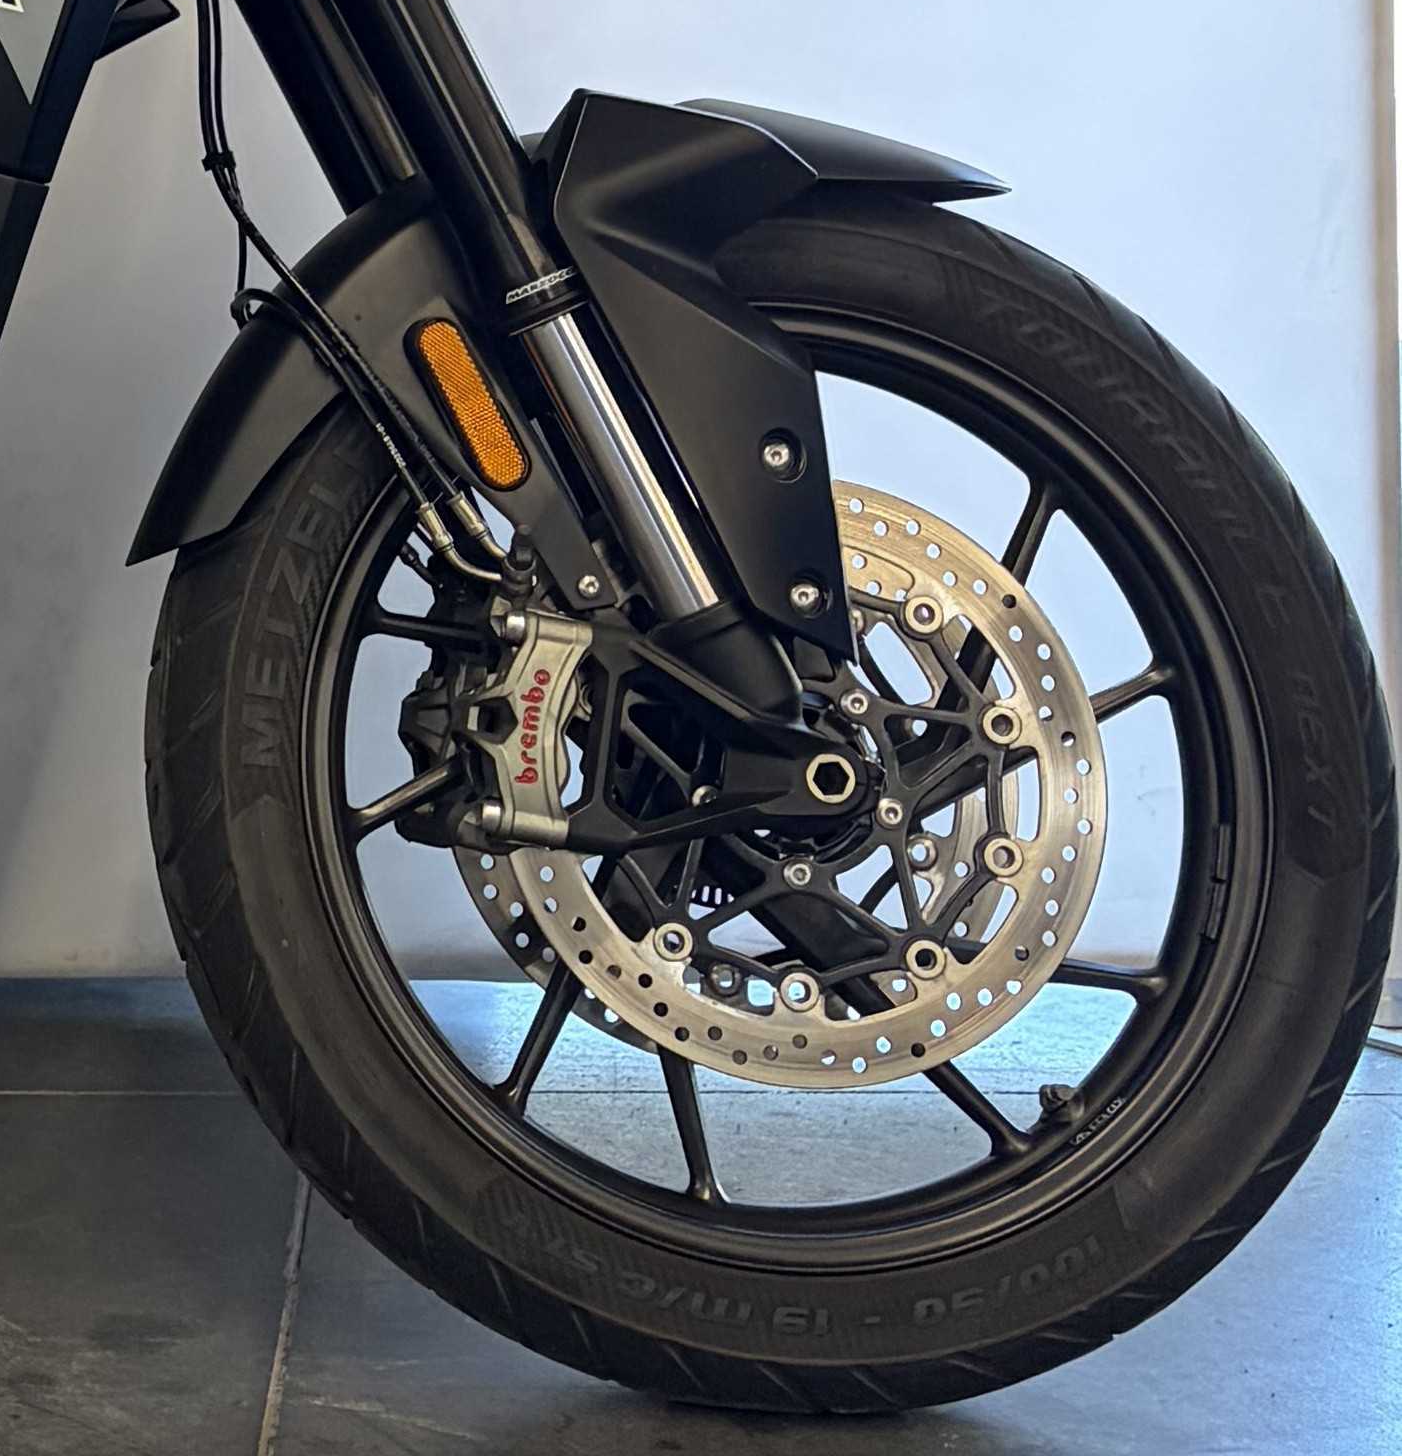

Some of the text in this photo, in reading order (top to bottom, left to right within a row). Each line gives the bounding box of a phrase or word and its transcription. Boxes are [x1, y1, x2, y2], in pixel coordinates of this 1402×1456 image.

[239, 429, 364, 768] METZEL
[514, 668, 551, 785] brembo
[772, 1304, 831, 1335] 19
[913, 1232, 1104, 1324] 100/90
